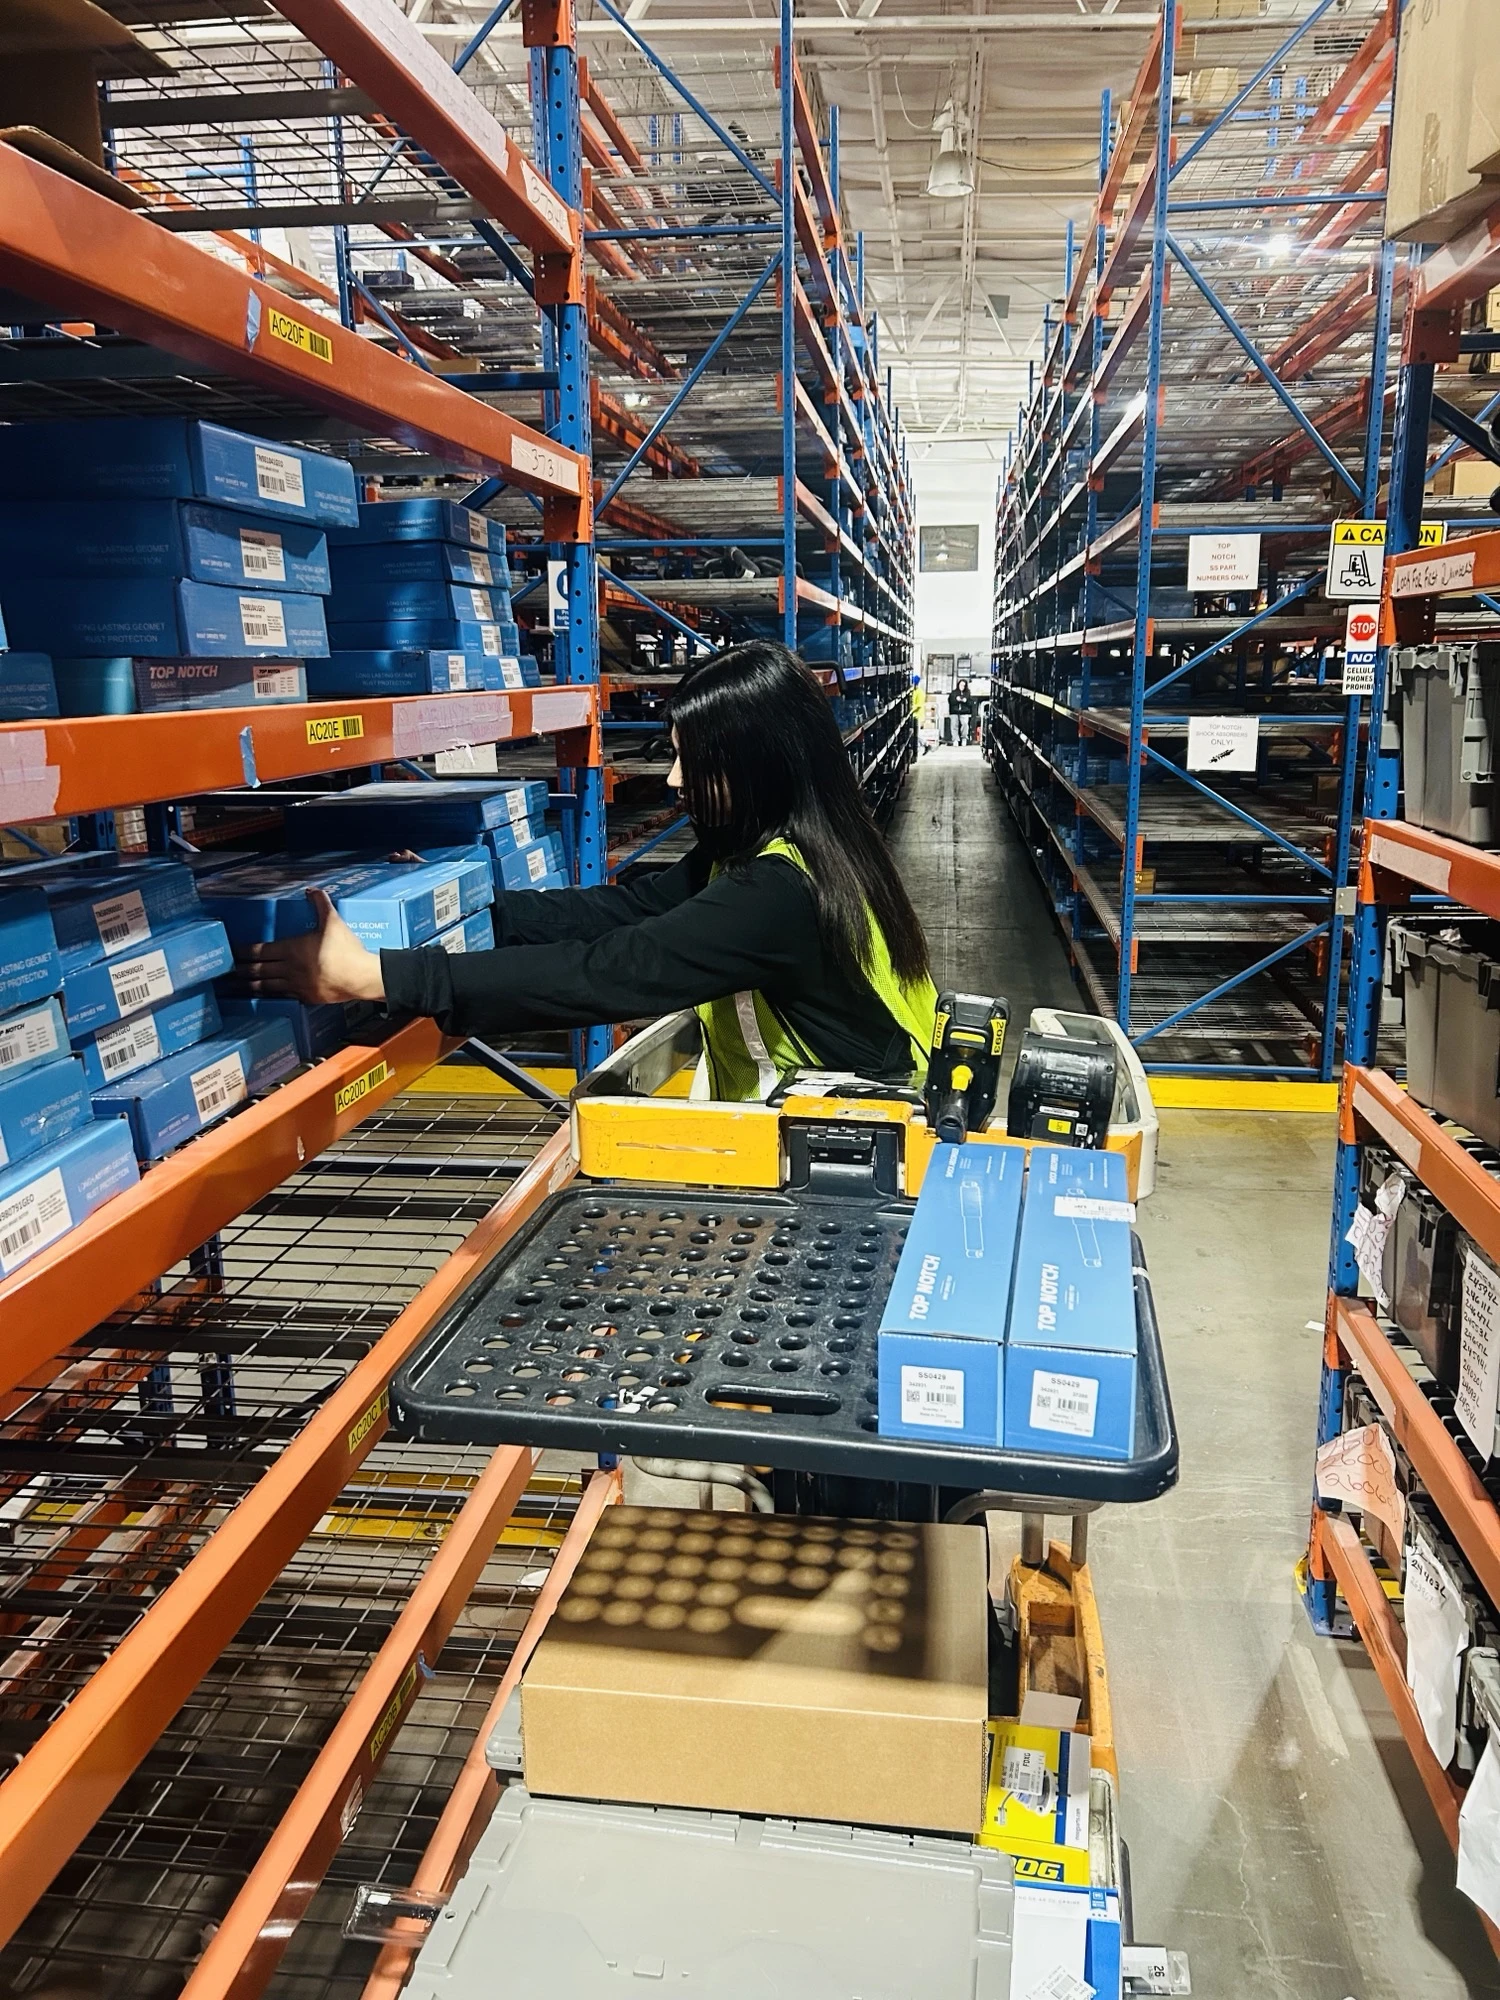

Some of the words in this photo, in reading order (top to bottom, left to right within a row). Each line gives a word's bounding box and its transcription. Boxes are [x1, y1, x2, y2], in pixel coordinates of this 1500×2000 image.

[272, 314, 305, 347] AC20F
[97, 622, 130, 632] LASTING
[132, 621, 165, 631] GEOMET
[1350, 622, 1377, 634] STOP
[107, 634, 158, 643] PROTECTION
[149, 666, 175, 680] TOP
[178, 665, 218, 679] NOTCH
[309, 720, 340, 740] AC20E
[358, 922, 390, 930] GEOMET
[25, 952, 52, 968] GEOMET
[7, 968, 49, 988] PROTECTION
[5, 1022, 25, 1035] NOTCH
[993, 1021, 1004, 1054] 2093
[337, 1079, 366, 1110] AC20D
[20, 1115, 37, 1128] LONG
[60, 1089, 83, 1108] GEOMET
[99, 1166, 130, 1190] PROTECTION
[916, 1254, 942, 1294] NOTCH
[1039, 1263, 1060, 1305] NOTCH
[909, 1295, 930, 1321] TOP
[1037, 1305, 1058, 1331] TOP
[918, 1372, 947, 1380] SS0429
[1051, 1378, 1081, 1388] SS0429
[350, 1404, 378, 1449] AC20C
[372, 1706, 398, 1755] AC20B
[1012, 1857, 1061, 1880] OG
[1154, 1965, 1165, 1978] 26
